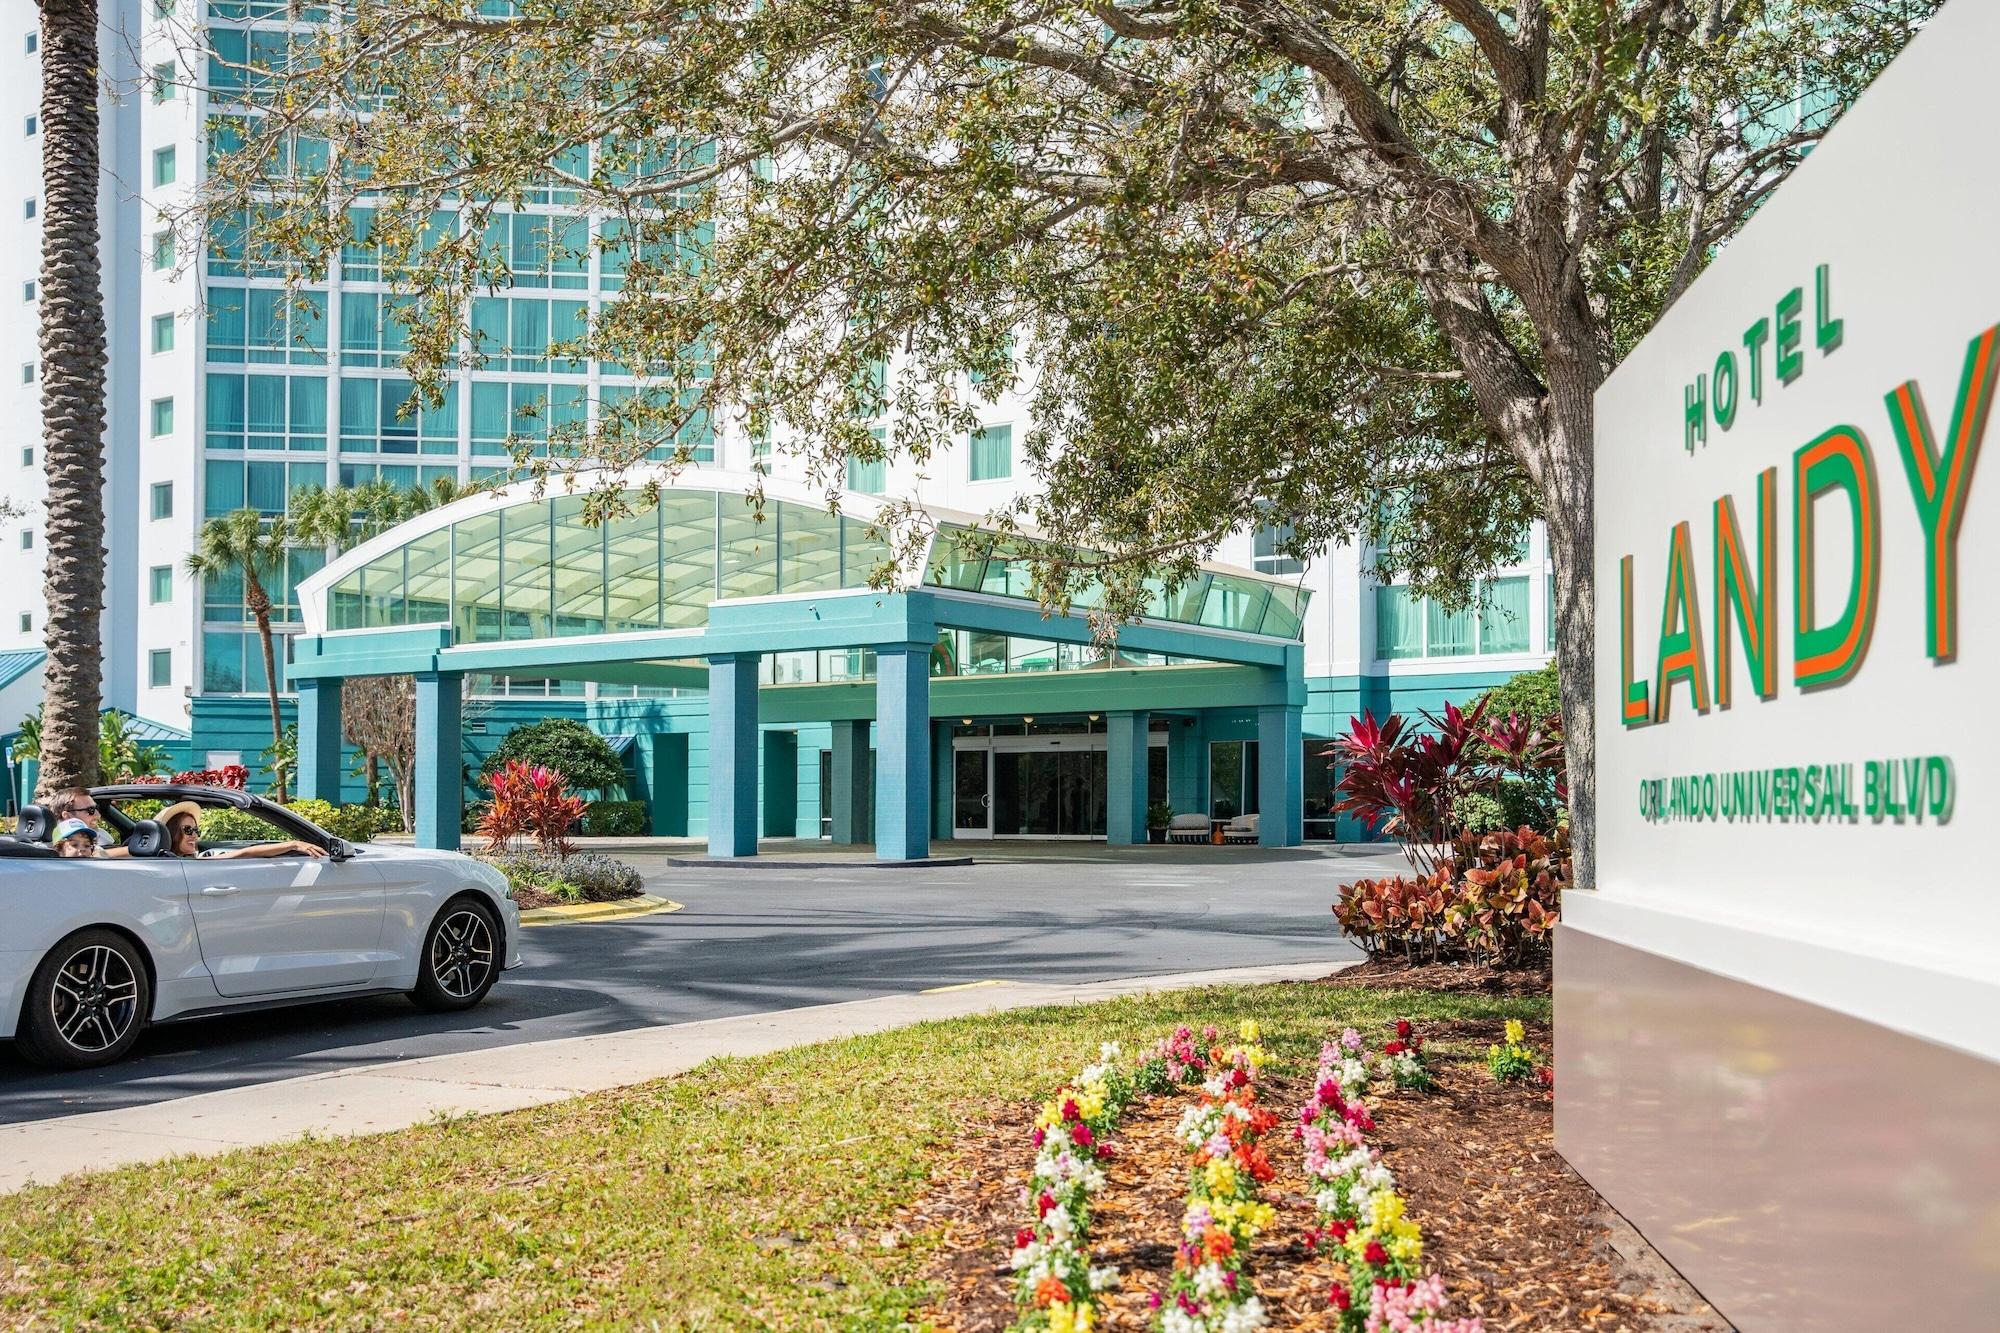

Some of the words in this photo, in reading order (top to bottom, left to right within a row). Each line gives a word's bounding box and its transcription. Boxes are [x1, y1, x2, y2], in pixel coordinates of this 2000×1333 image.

[1685, 265, 1842, 453] HOTEL
[1620, 322, 2000, 728] LANDY
[1639, 773, 1715, 818] ORLANDO
[1720, 763, 1857, 818] UNIVERSAL
[1864, 756, 1953, 820] BLVD
